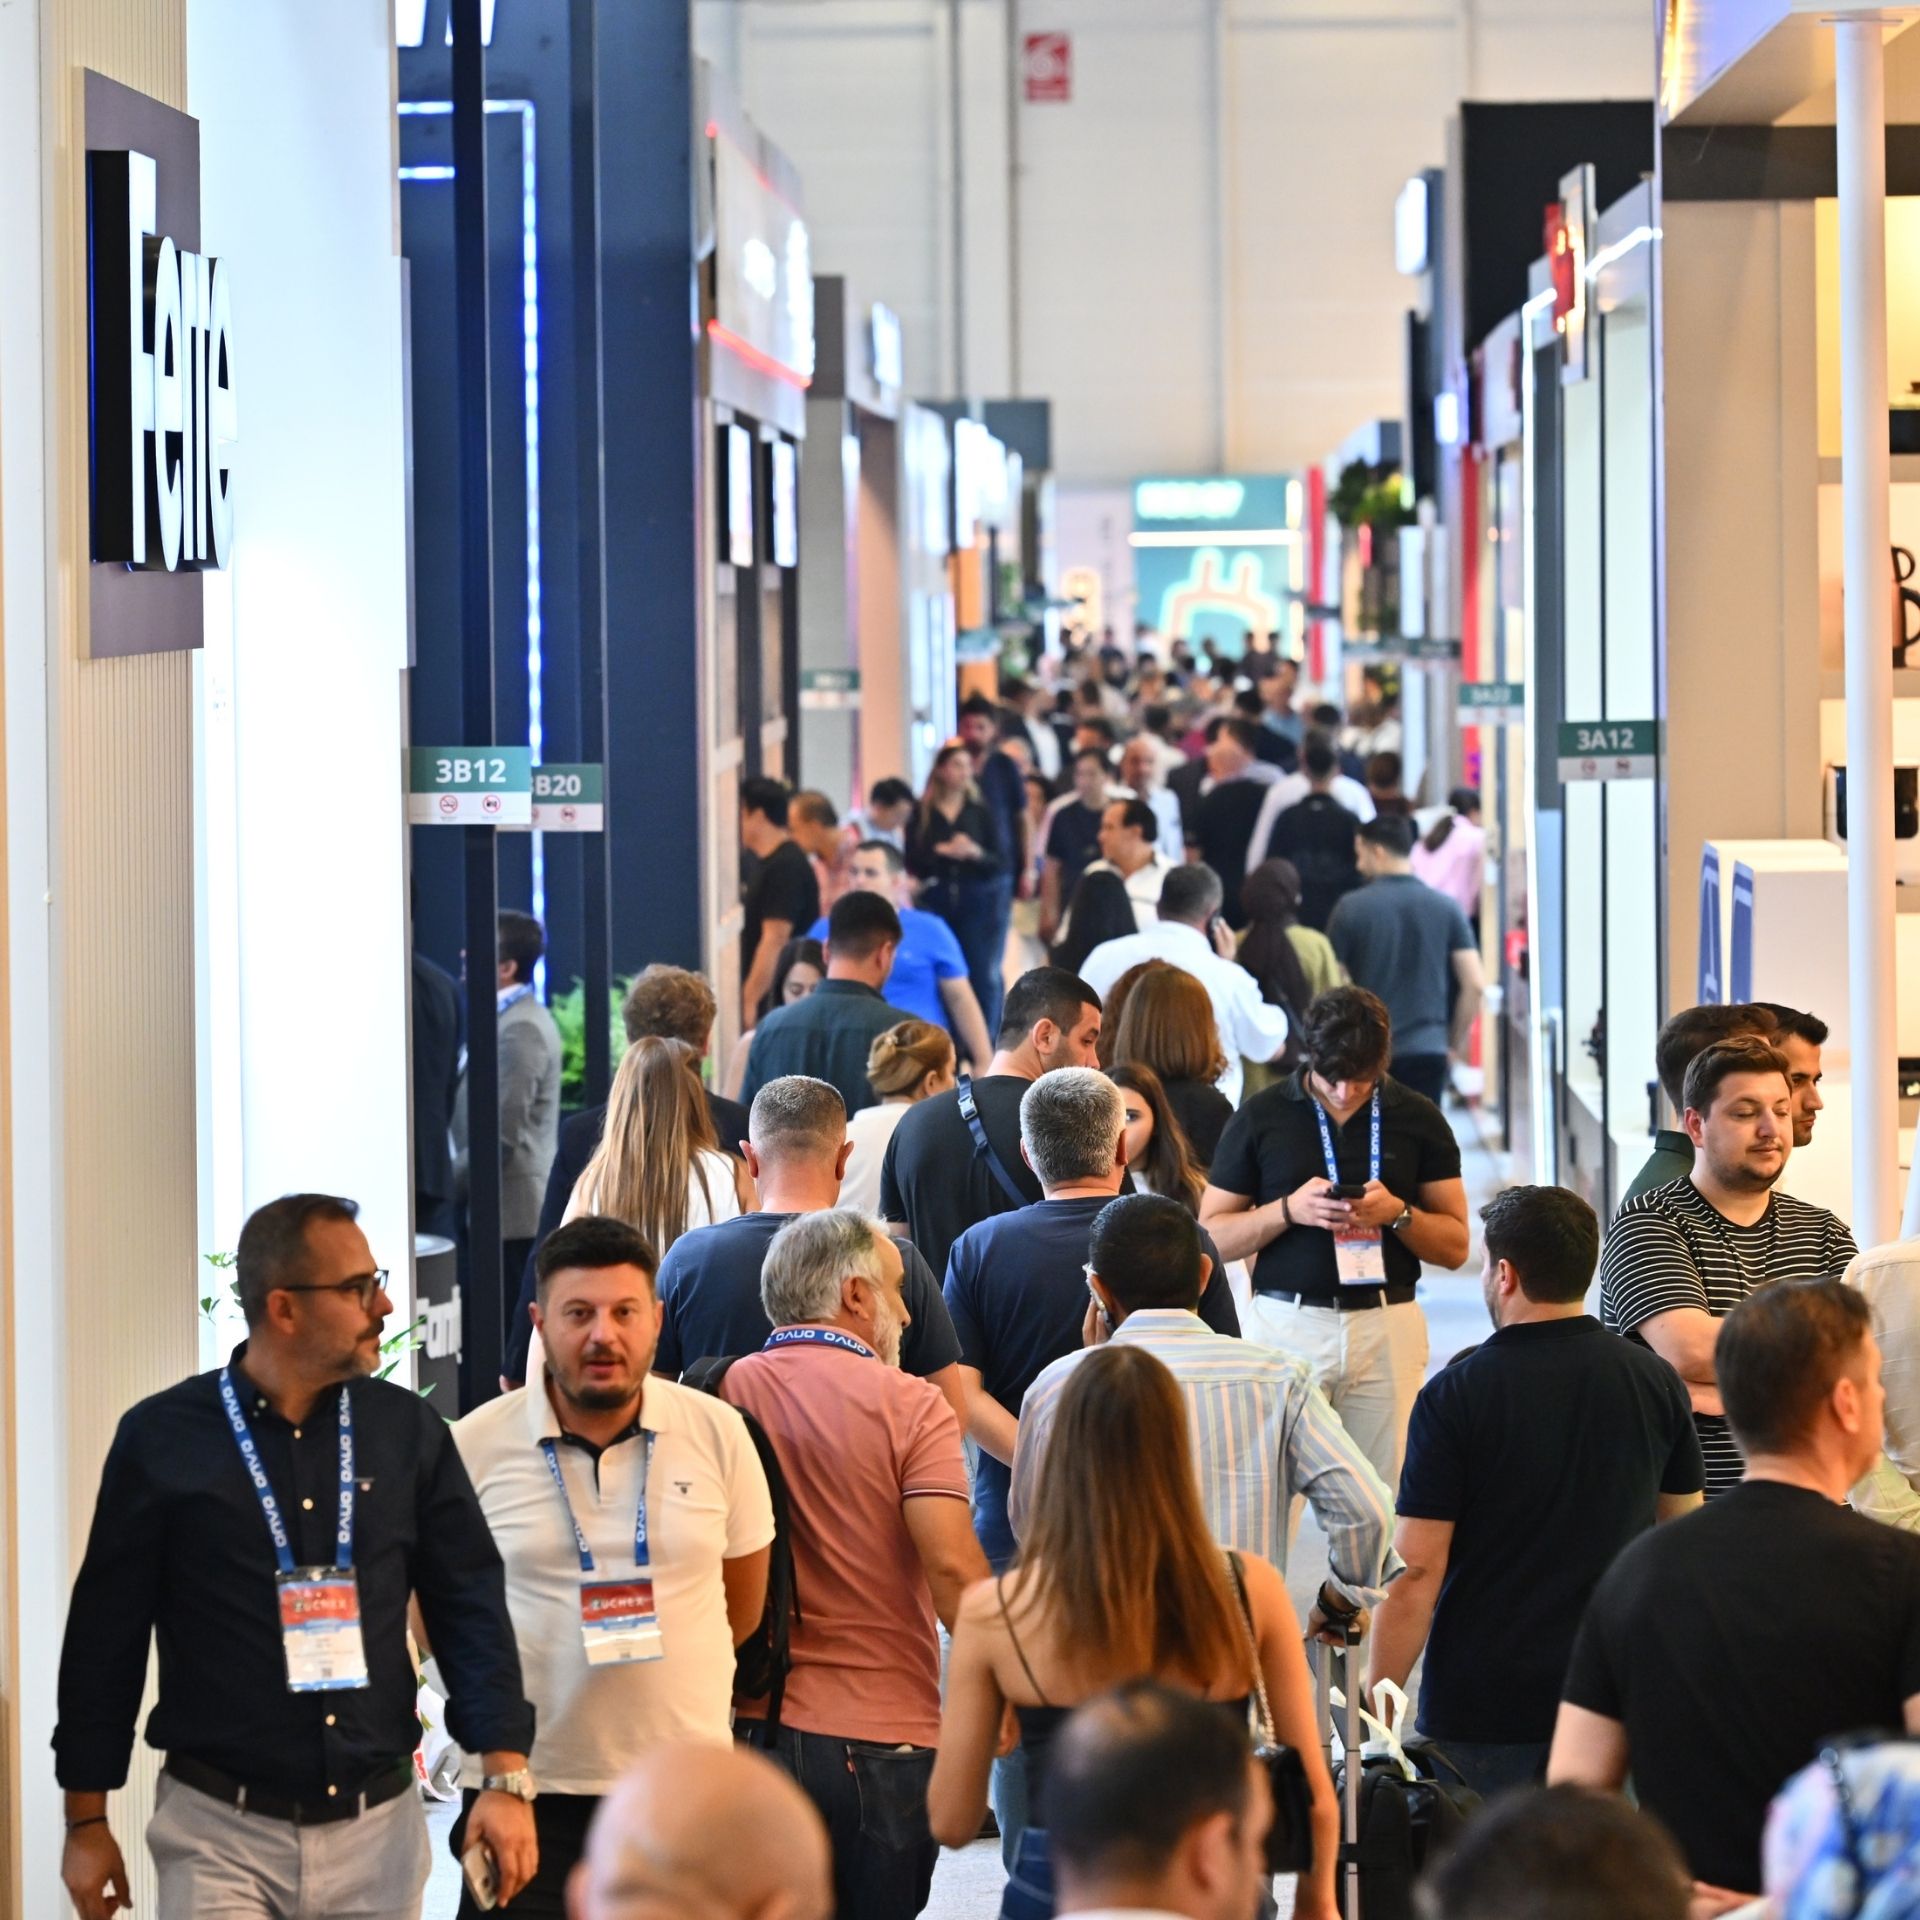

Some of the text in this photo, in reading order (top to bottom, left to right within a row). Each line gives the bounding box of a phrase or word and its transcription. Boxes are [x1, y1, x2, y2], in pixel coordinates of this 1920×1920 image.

[128, 148, 238, 573] Ferre
[1577, 728, 1635, 751] 3A12
[435, 758, 507, 784] 3B12
[531, 774, 582, 797] B20
